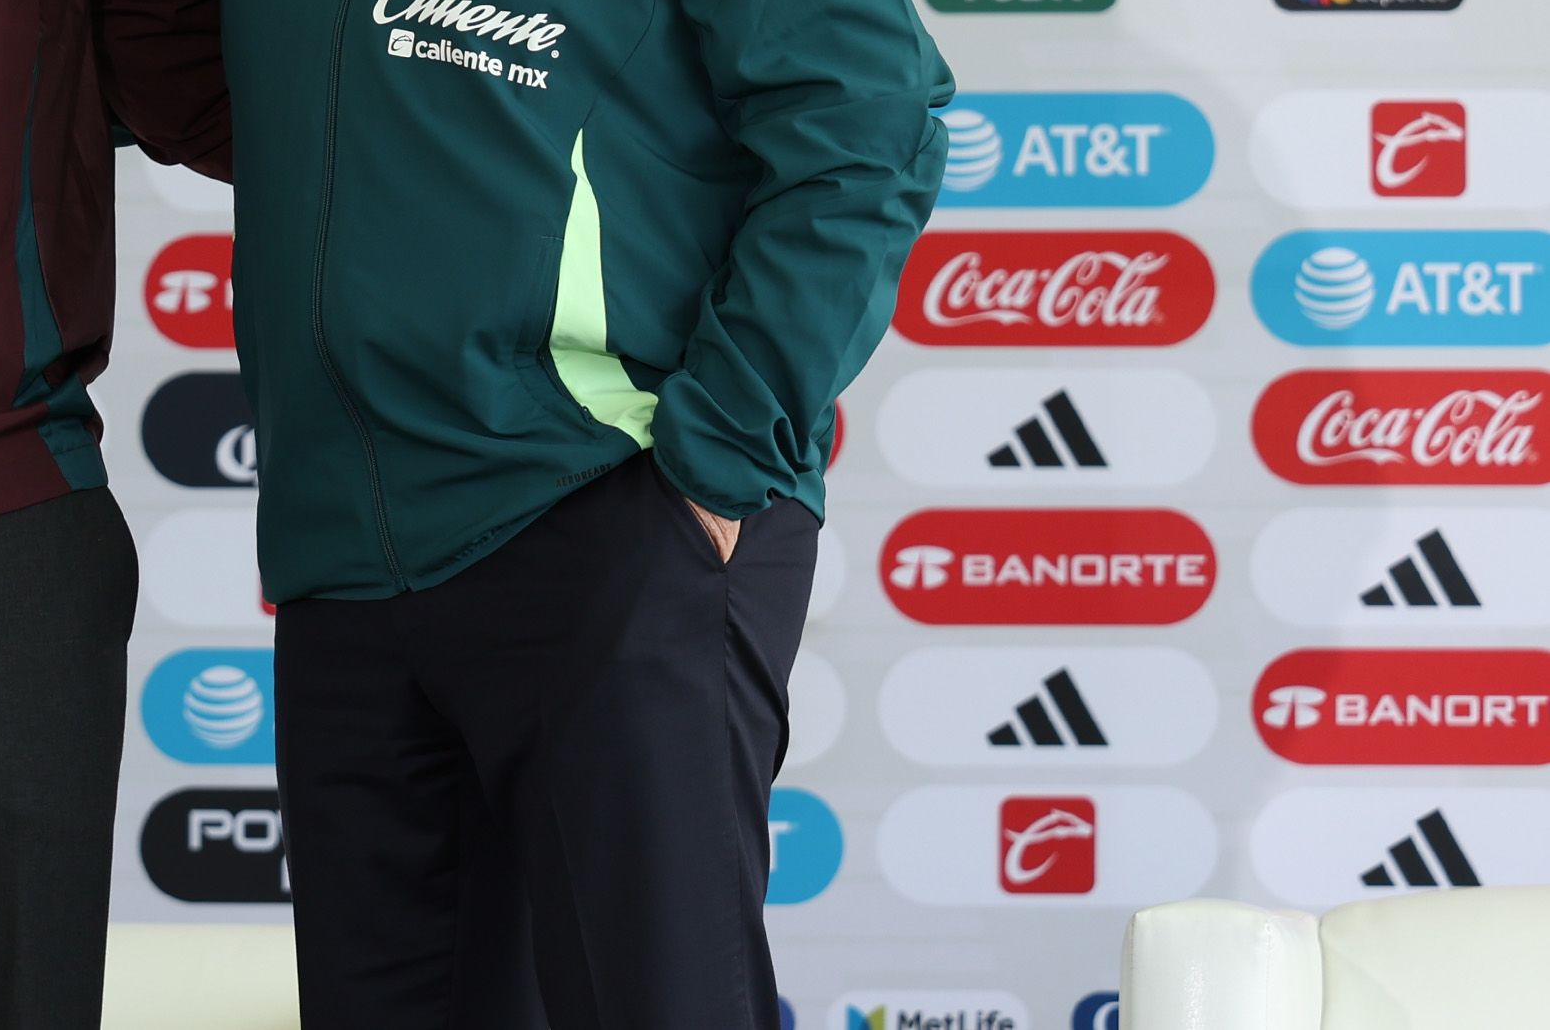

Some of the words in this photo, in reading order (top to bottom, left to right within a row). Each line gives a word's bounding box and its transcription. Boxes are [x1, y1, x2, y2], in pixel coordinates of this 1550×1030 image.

[415, 39, 503, 76] caliente
[507, 63, 549, 89] mx
[1012, 124, 1160, 177] AT&T
[923, 251, 1168, 327] Coca-Cola
[1386, 261, 1533, 314] AT&T
[1296, 389, 1542, 466] Coca-Cola
[962, 554, 1206, 586] BANORTE
[1336, 694, 1549, 726] BANORT
